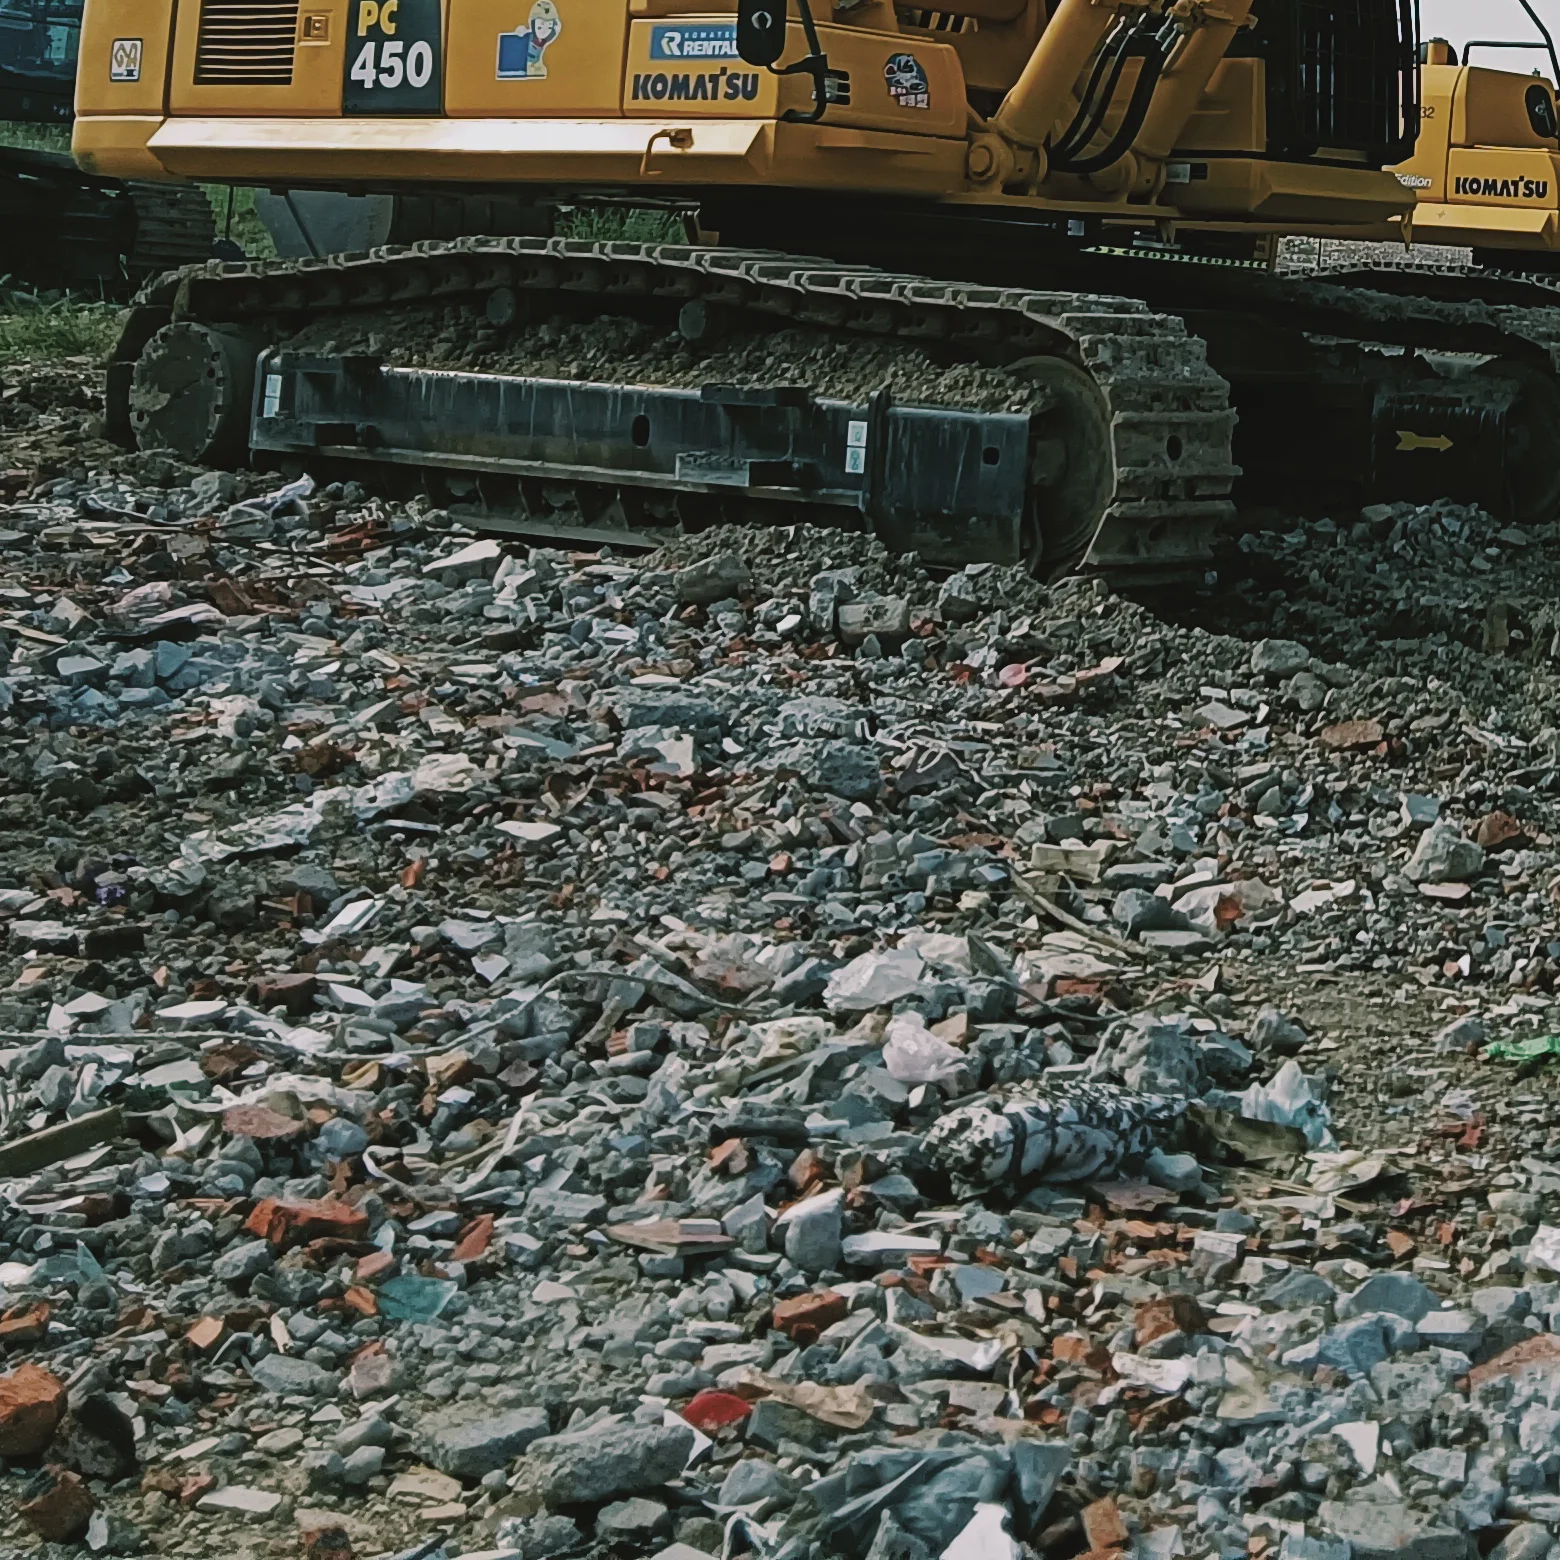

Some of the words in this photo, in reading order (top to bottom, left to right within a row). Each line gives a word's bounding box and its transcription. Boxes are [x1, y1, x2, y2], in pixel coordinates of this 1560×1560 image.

[683, 40, 740, 55] RENTAL
[350, 40, 433, 89] 450
[631, 66, 760, 101] KOMATSU
[1454, 175, 1548, 199] KOMATSU
